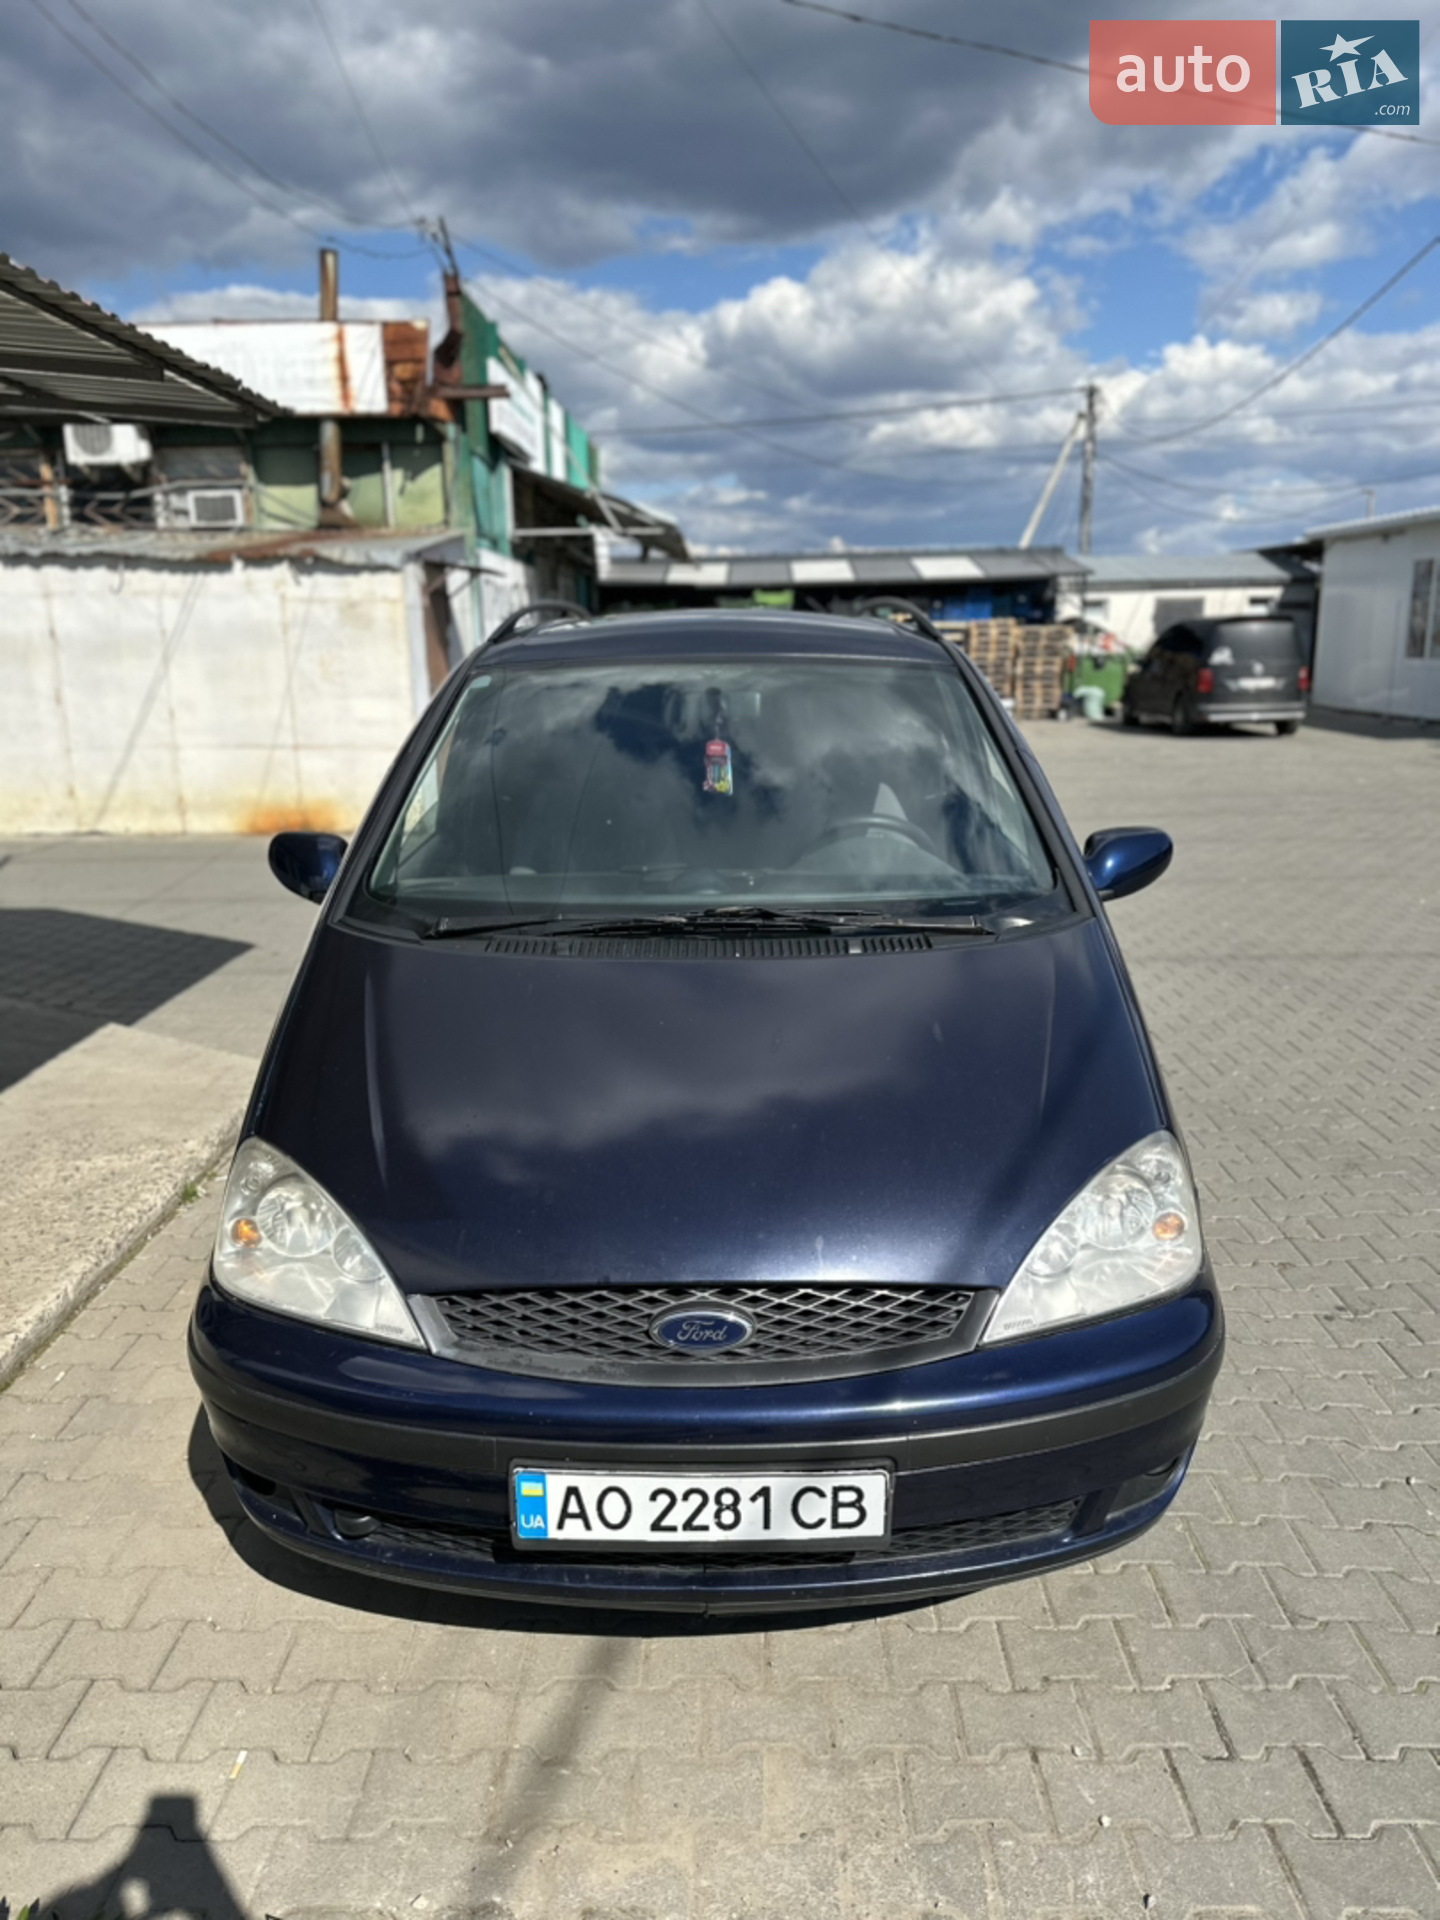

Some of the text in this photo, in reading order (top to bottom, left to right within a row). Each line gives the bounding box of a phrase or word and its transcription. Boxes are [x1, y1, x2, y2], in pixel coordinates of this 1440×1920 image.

[677, 1320, 728, 1342] Ford
[556, 1486, 867, 1532] AO 2281 CB
[521, 1515, 545, 1529] UA
